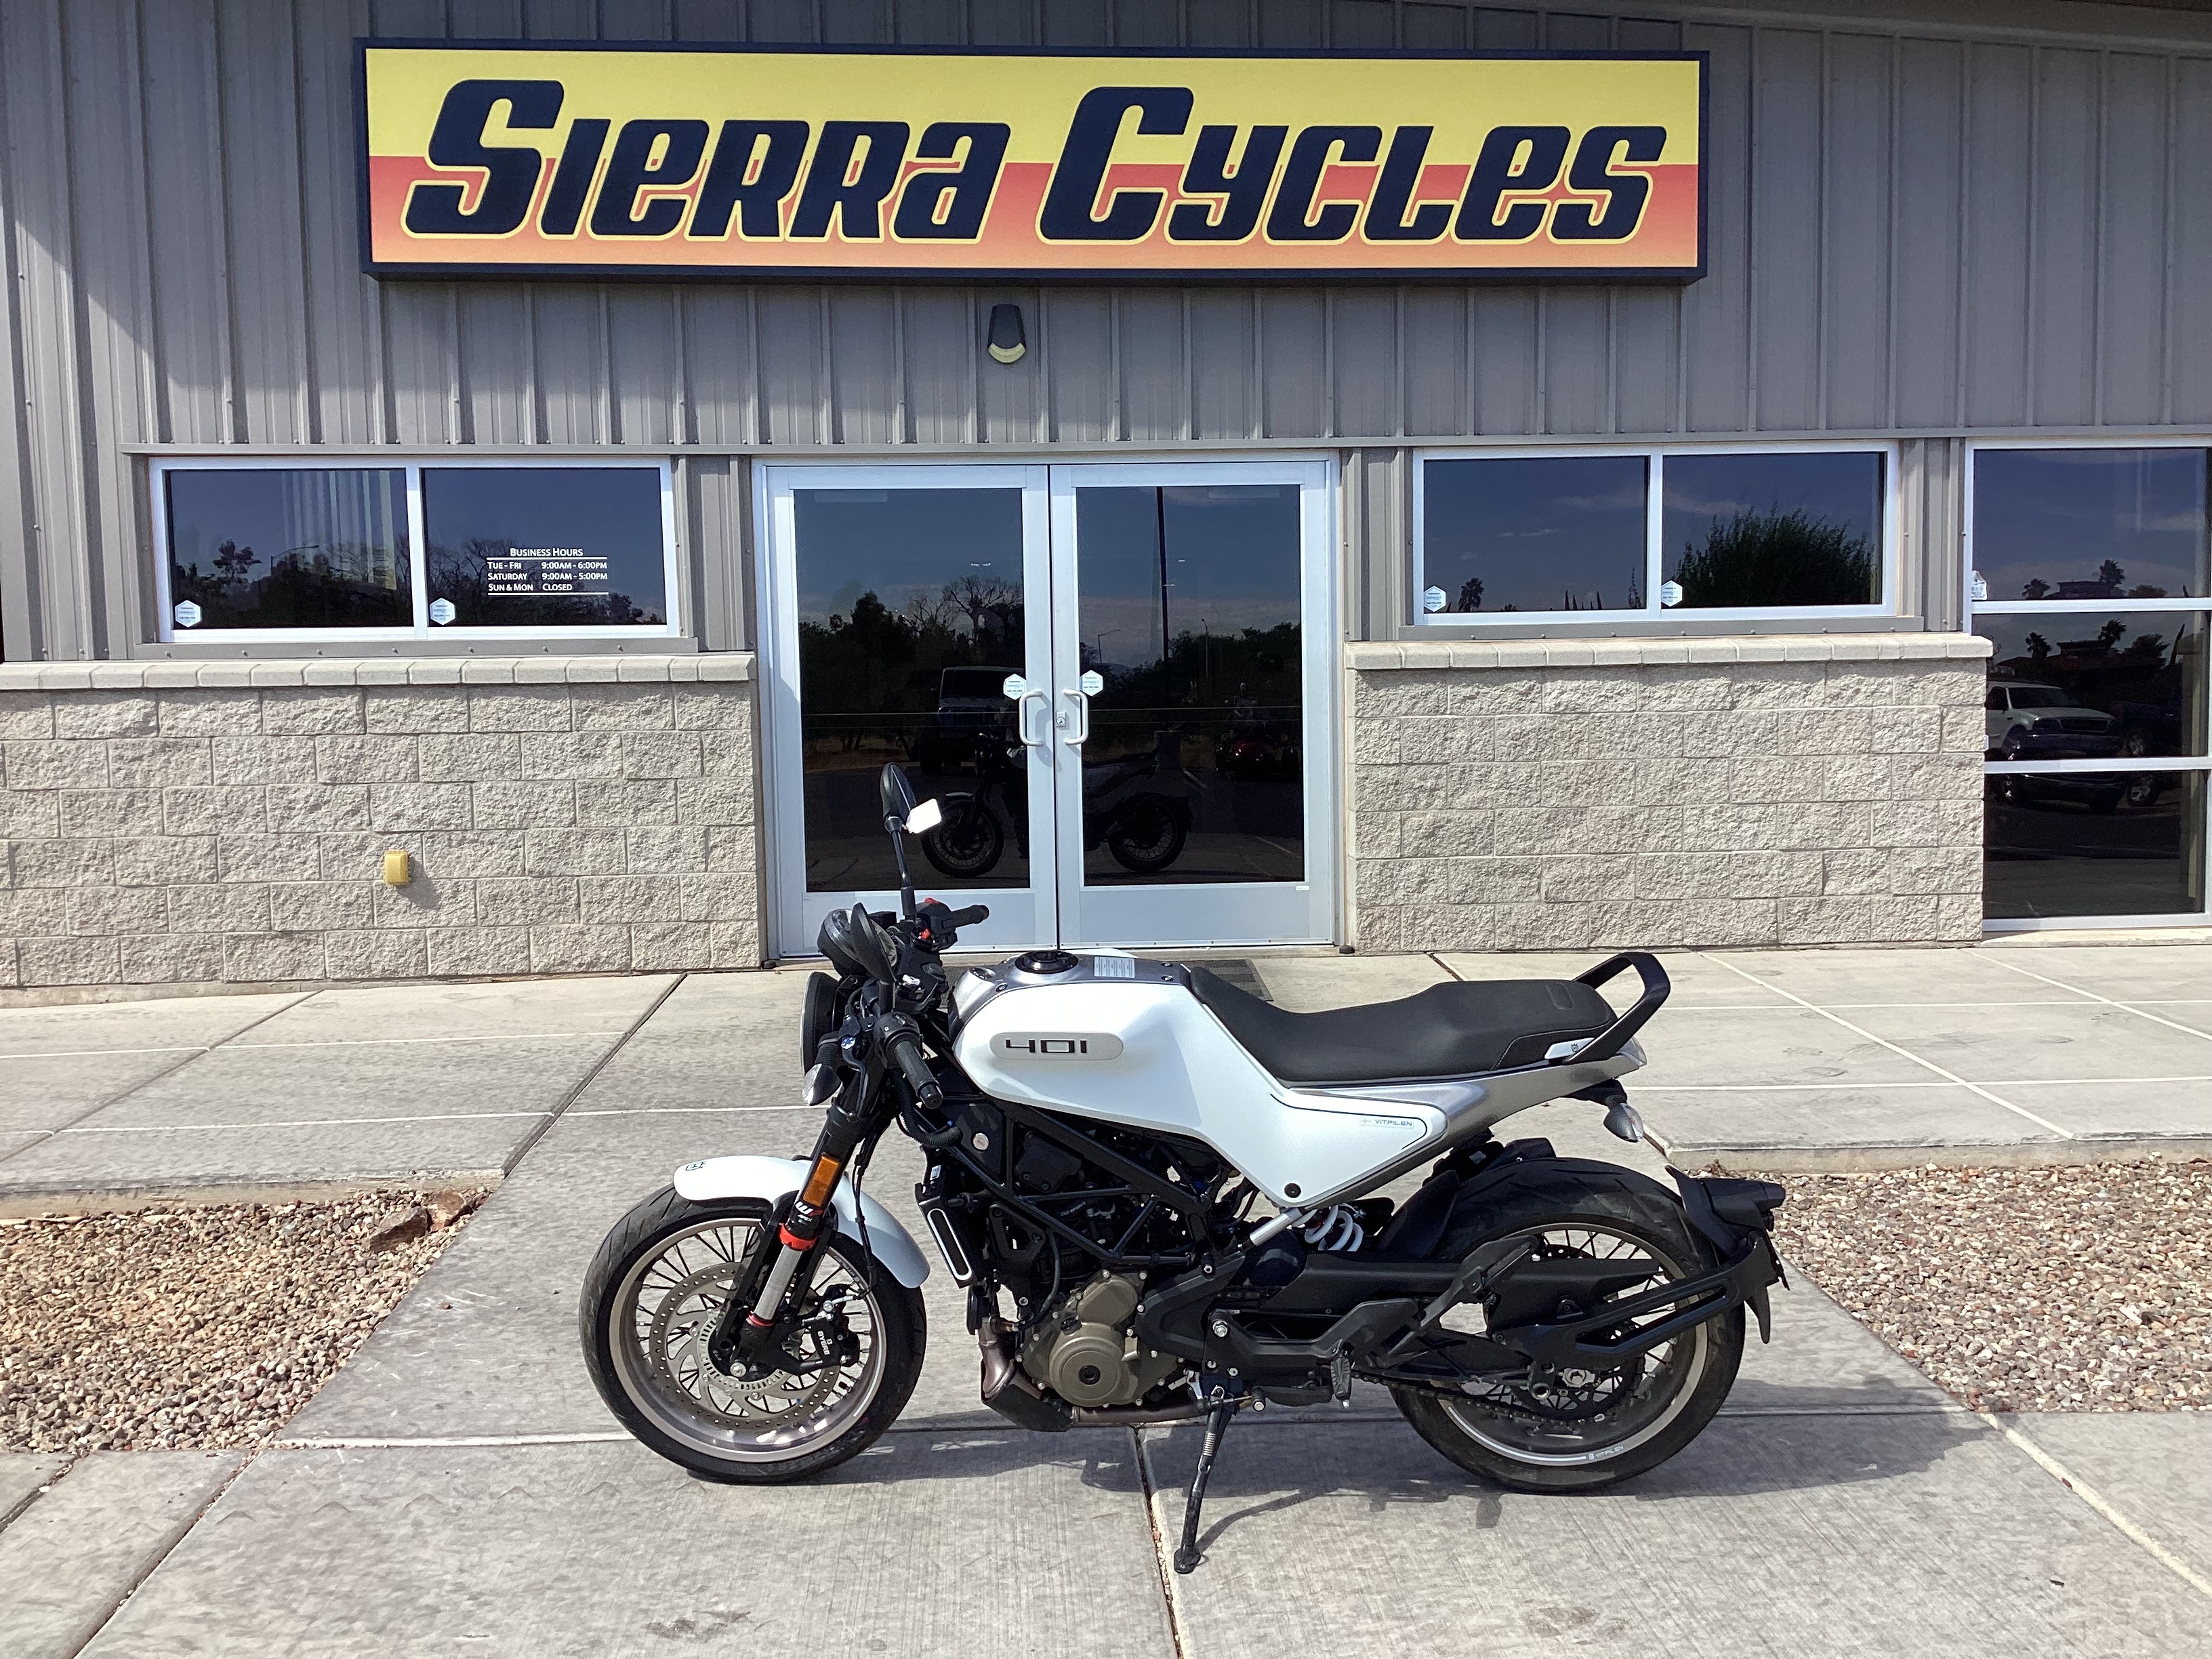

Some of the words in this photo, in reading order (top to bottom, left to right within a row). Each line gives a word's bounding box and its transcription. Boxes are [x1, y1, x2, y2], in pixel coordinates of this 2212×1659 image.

[510, 548, 551, 556] BUSINESS
[552, 548, 583, 556] HOURS
[487, 561, 503, 569] TUE
[509, 561, 522, 569] FRI
[541, 561, 572, 569] 9:00AM
[577, 561, 608, 569] 6:00PM
[487, 572, 528, 581] SATURDAY
[541, 572, 573, 580] 9:00AM
[578, 572, 608, 580] 5:00PM
[488, 583, 506, 592] SUN
[506, 583, 512, 592] &
[513, 583, 533, 591] MON
[542, 583, 573, 591] CLOSED
[1005, 1039, 1088, 1054] 401
